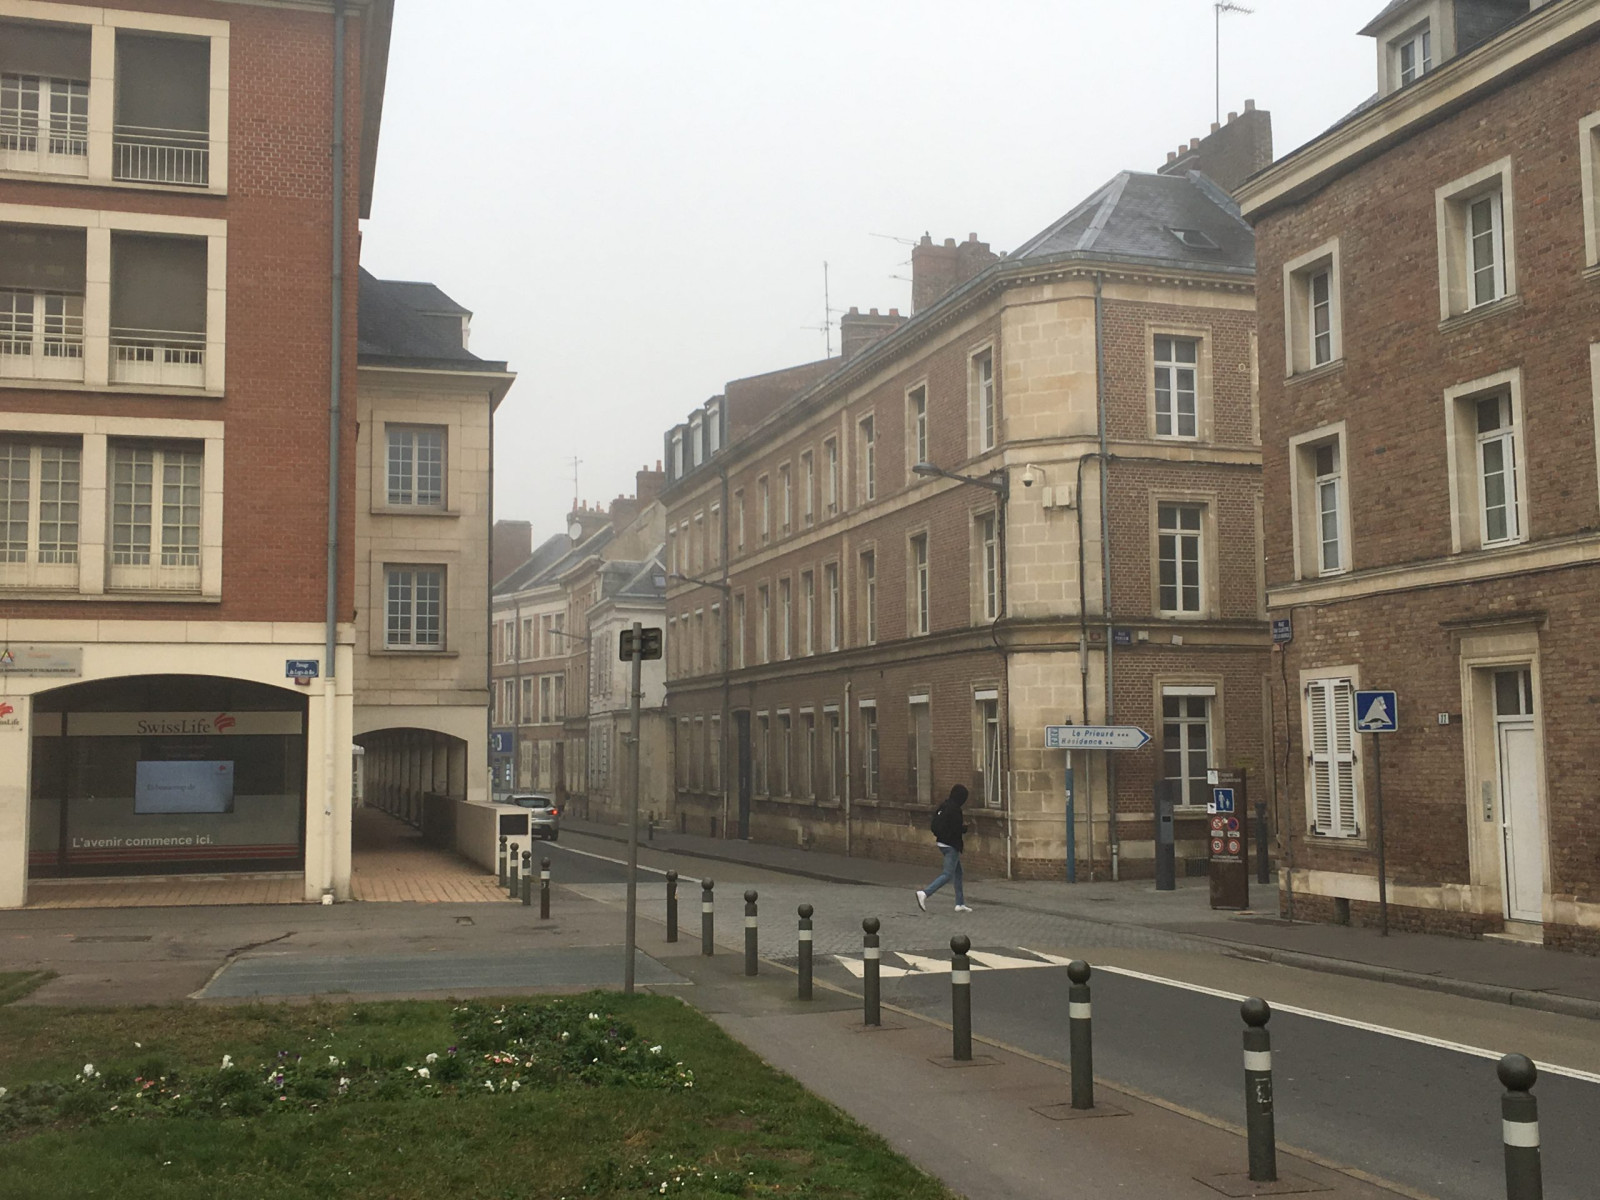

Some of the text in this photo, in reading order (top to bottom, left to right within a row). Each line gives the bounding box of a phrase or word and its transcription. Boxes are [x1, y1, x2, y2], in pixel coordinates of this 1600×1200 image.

[136, 718, 211, 734] SwissLife
[1071, 729, 1081, 737] Le
[72, 834, 214, 848] L'avenir commence ici.
